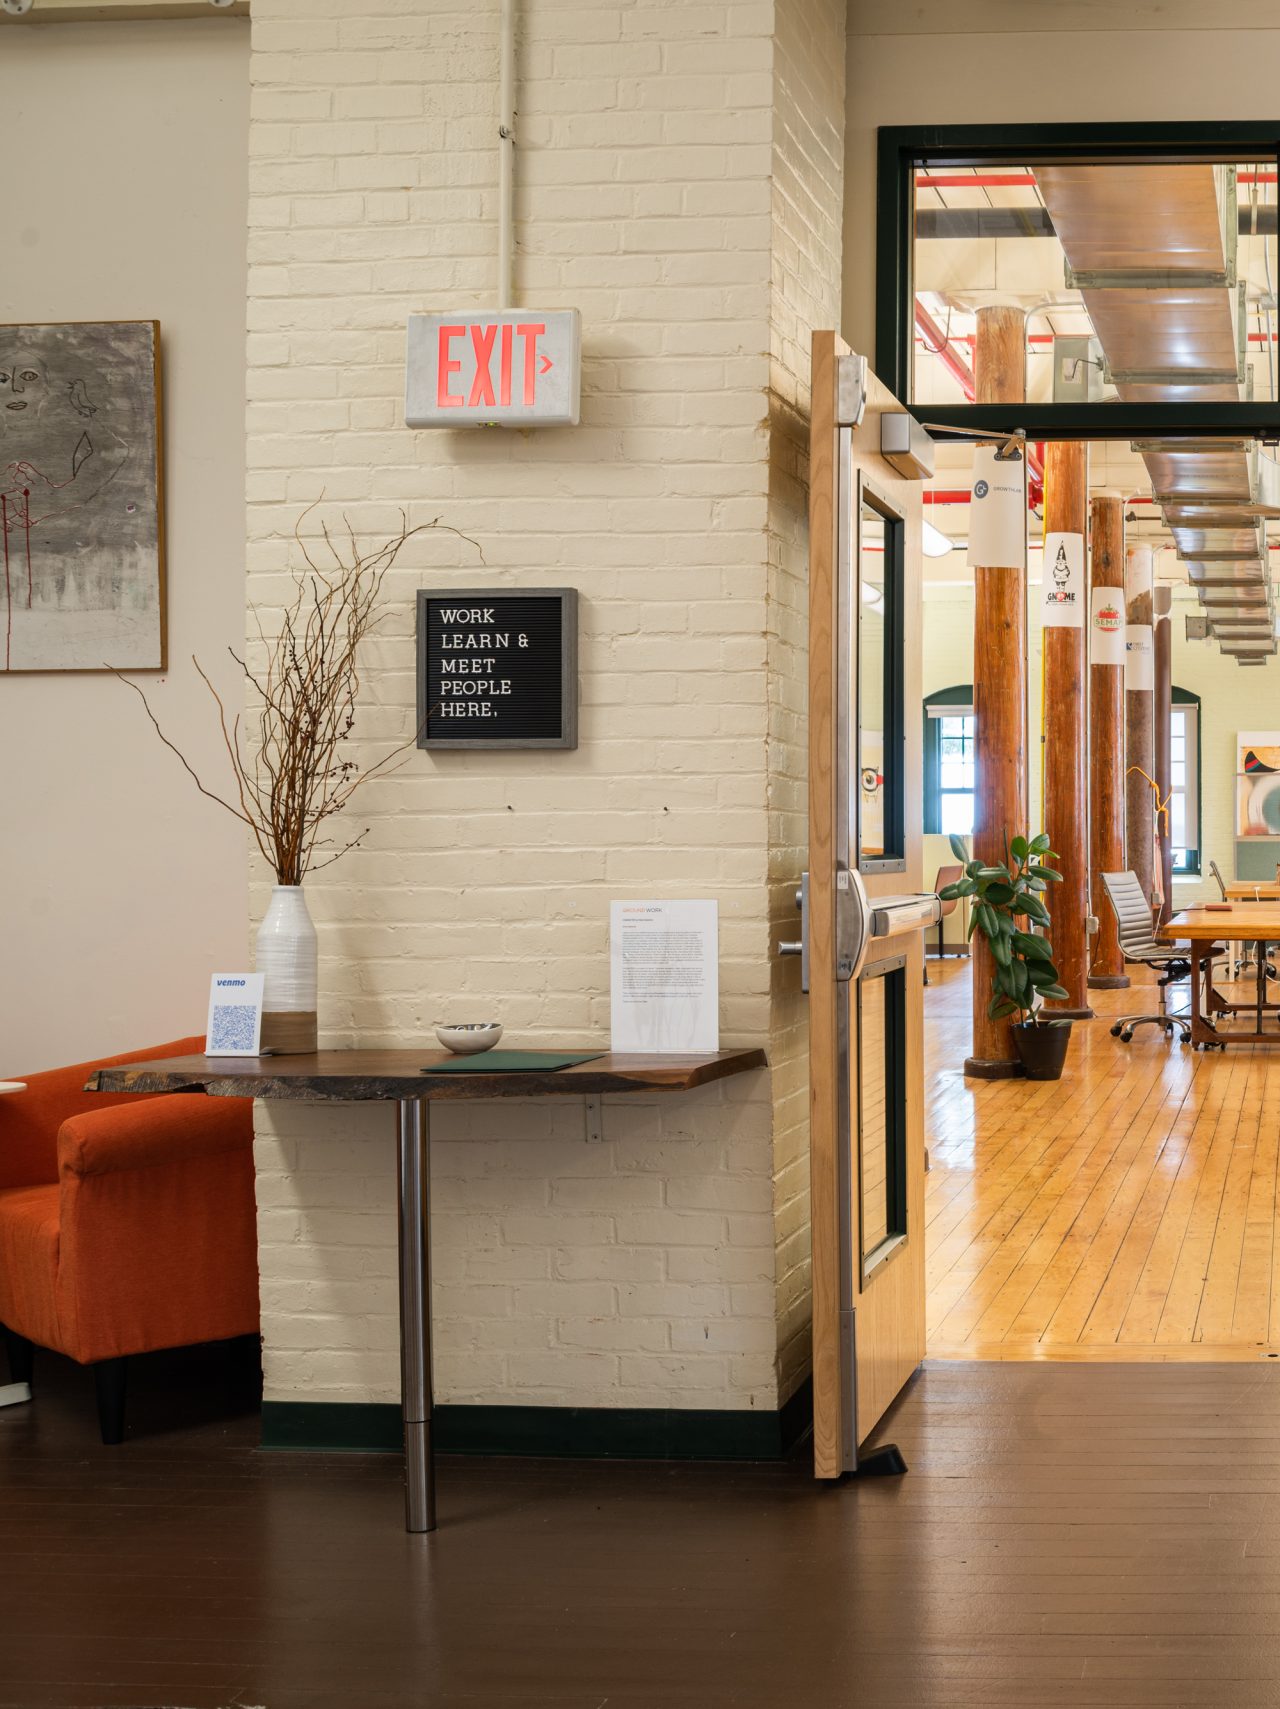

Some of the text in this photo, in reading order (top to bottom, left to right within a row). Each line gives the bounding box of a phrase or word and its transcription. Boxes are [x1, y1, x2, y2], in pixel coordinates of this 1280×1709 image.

[437, 323, 546, 408] EXIT
[440, 608, 495, 624] WORK
[441, 633, 529, 649] LEARN &
[441, 658, 496, 674] MEET
[440, 680, 512, 695] PEOPLE
[216, 979, 246, 987] venmo
